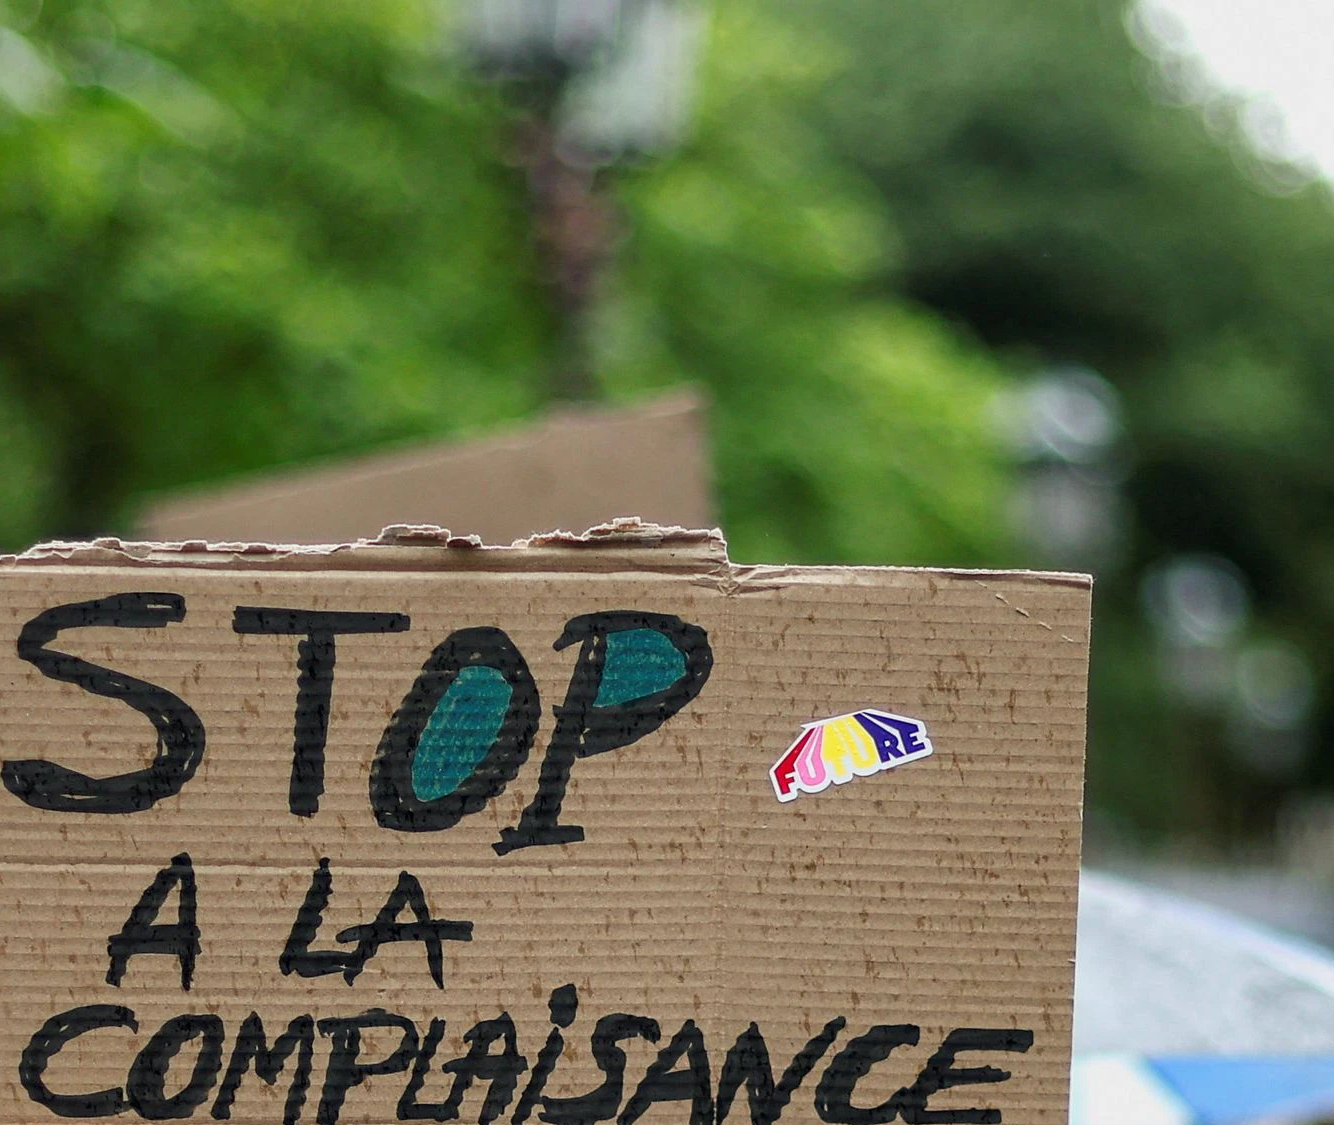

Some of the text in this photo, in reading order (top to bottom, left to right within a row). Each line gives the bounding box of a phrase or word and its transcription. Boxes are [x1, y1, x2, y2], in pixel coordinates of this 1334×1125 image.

[773, 711, 926, 795] FUTURE
[104, 851, 475, 992] A LA
